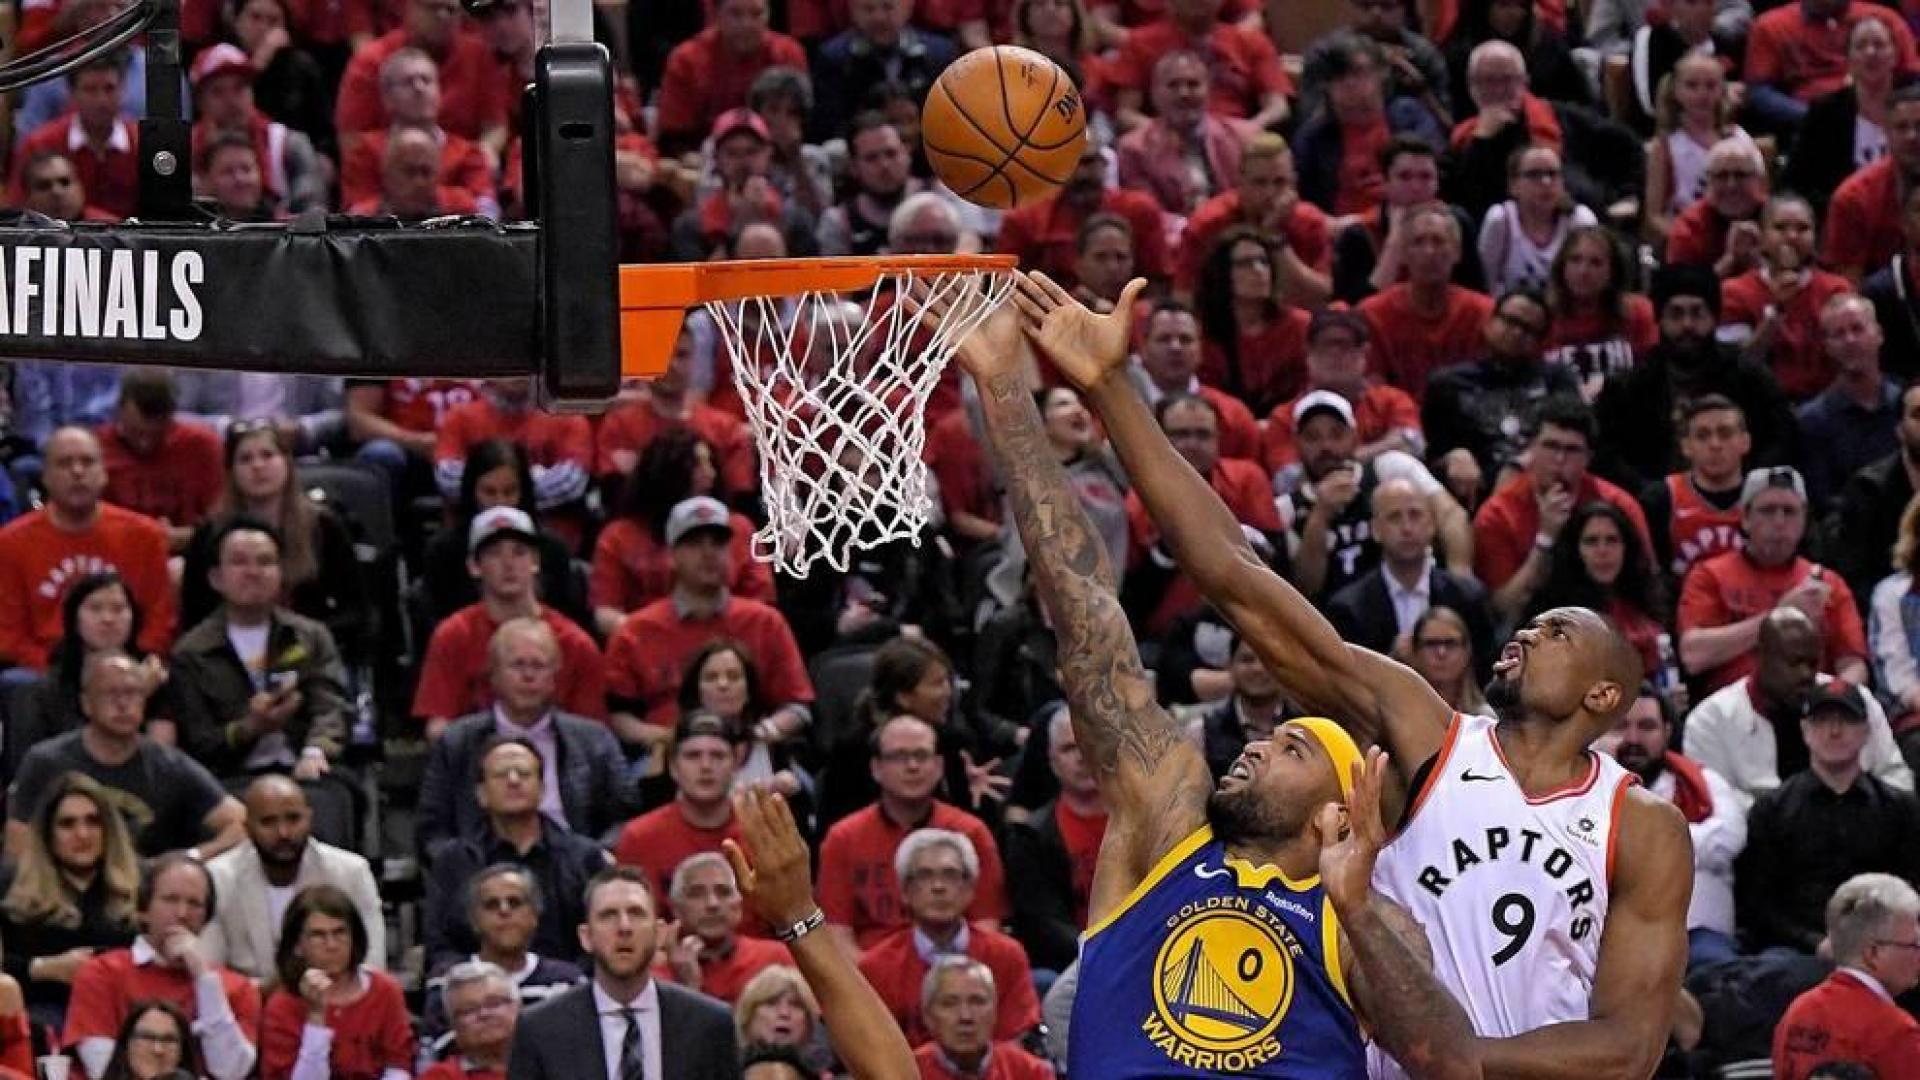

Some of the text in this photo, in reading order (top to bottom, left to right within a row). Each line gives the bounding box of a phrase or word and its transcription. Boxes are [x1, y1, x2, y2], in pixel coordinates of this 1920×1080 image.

[0, 246, 205, 342] FINALS
[1417, 826, 1594, 941] RAPTORS
[1166, 895, 1304, 959] GOLDEN STATE
[1491, 893, 1536, 967] 9
[1237, 947, 1263, 982] 0
[1142, 1011, 1283, 1071] WARRIORS
